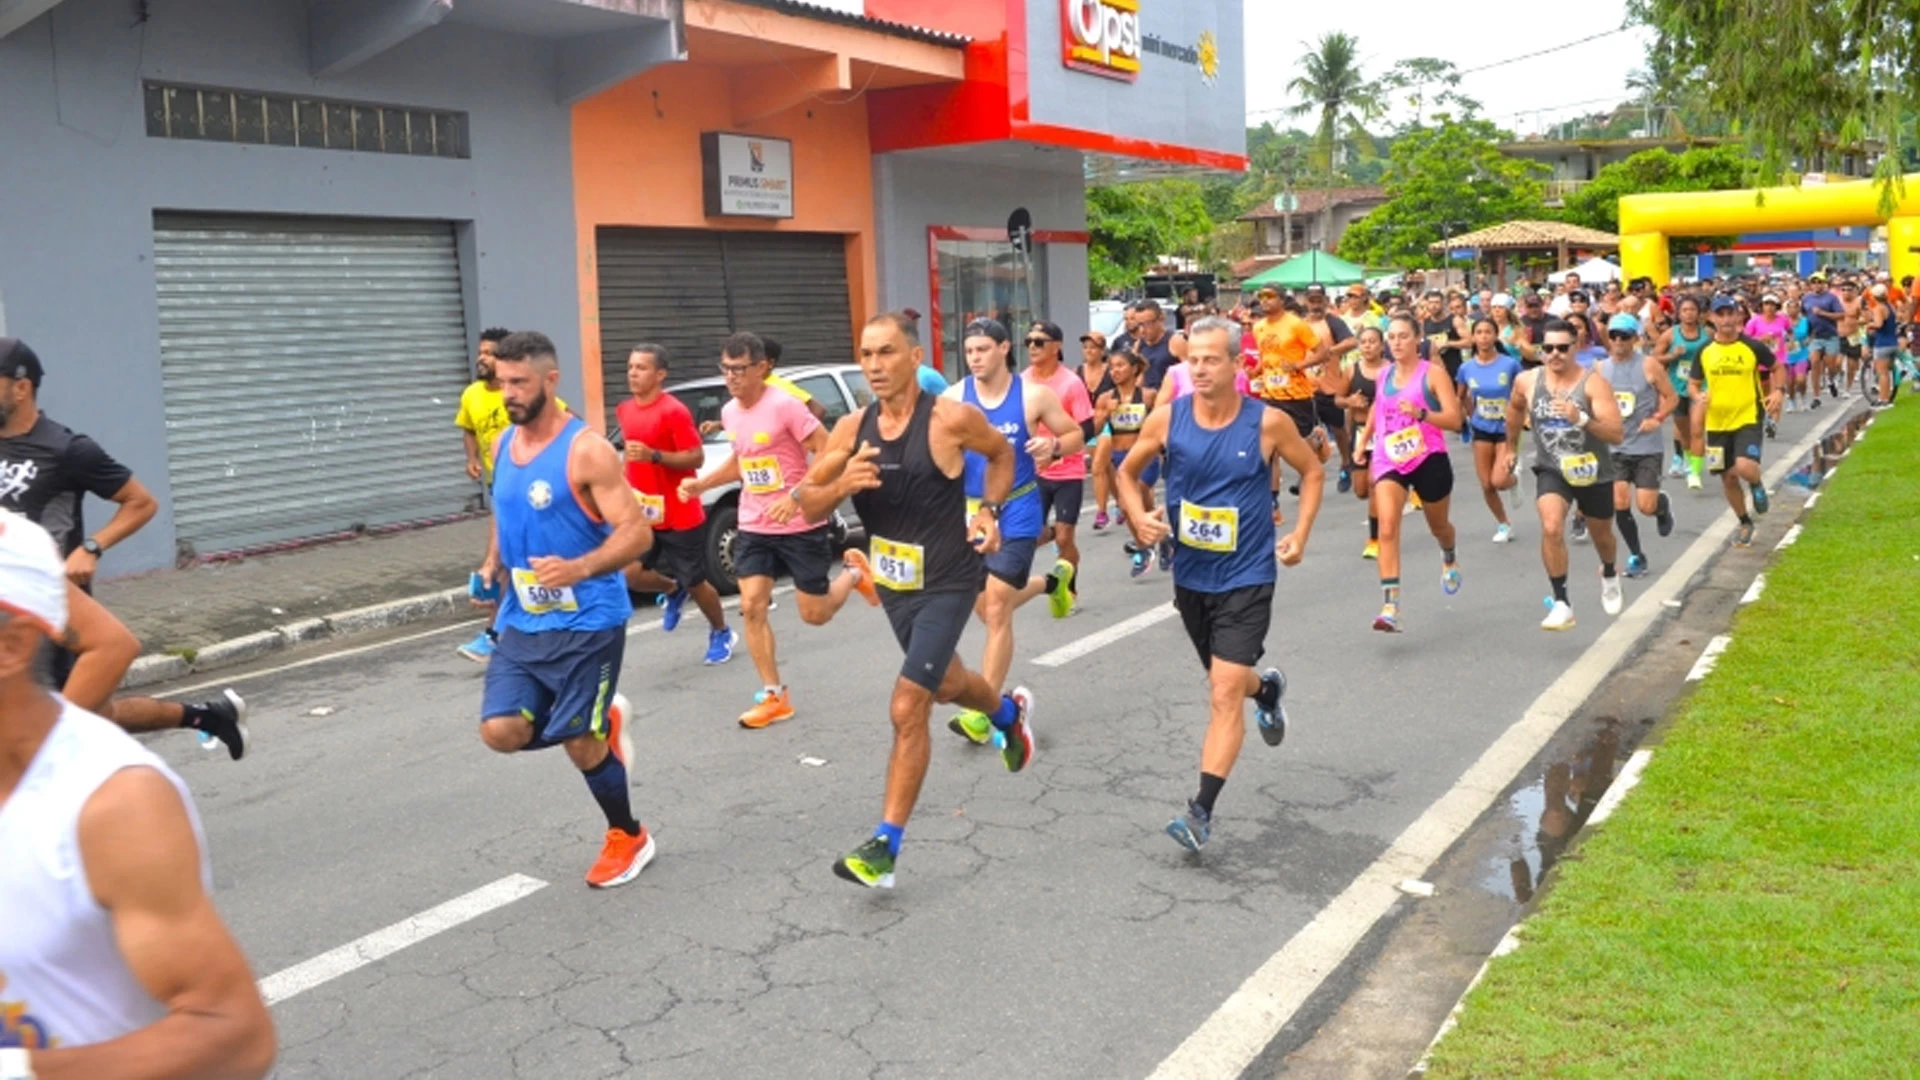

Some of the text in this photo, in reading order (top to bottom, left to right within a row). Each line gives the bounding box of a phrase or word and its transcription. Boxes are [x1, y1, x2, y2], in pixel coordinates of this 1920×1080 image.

[1142, 32, 1199, 65] mini mercado
[1393, 439, 1415, 455] 291
[747, 470, 771, 483] 128
[1188, 519, 1223, 538] 264
[879, 556, 906, 577] 051
